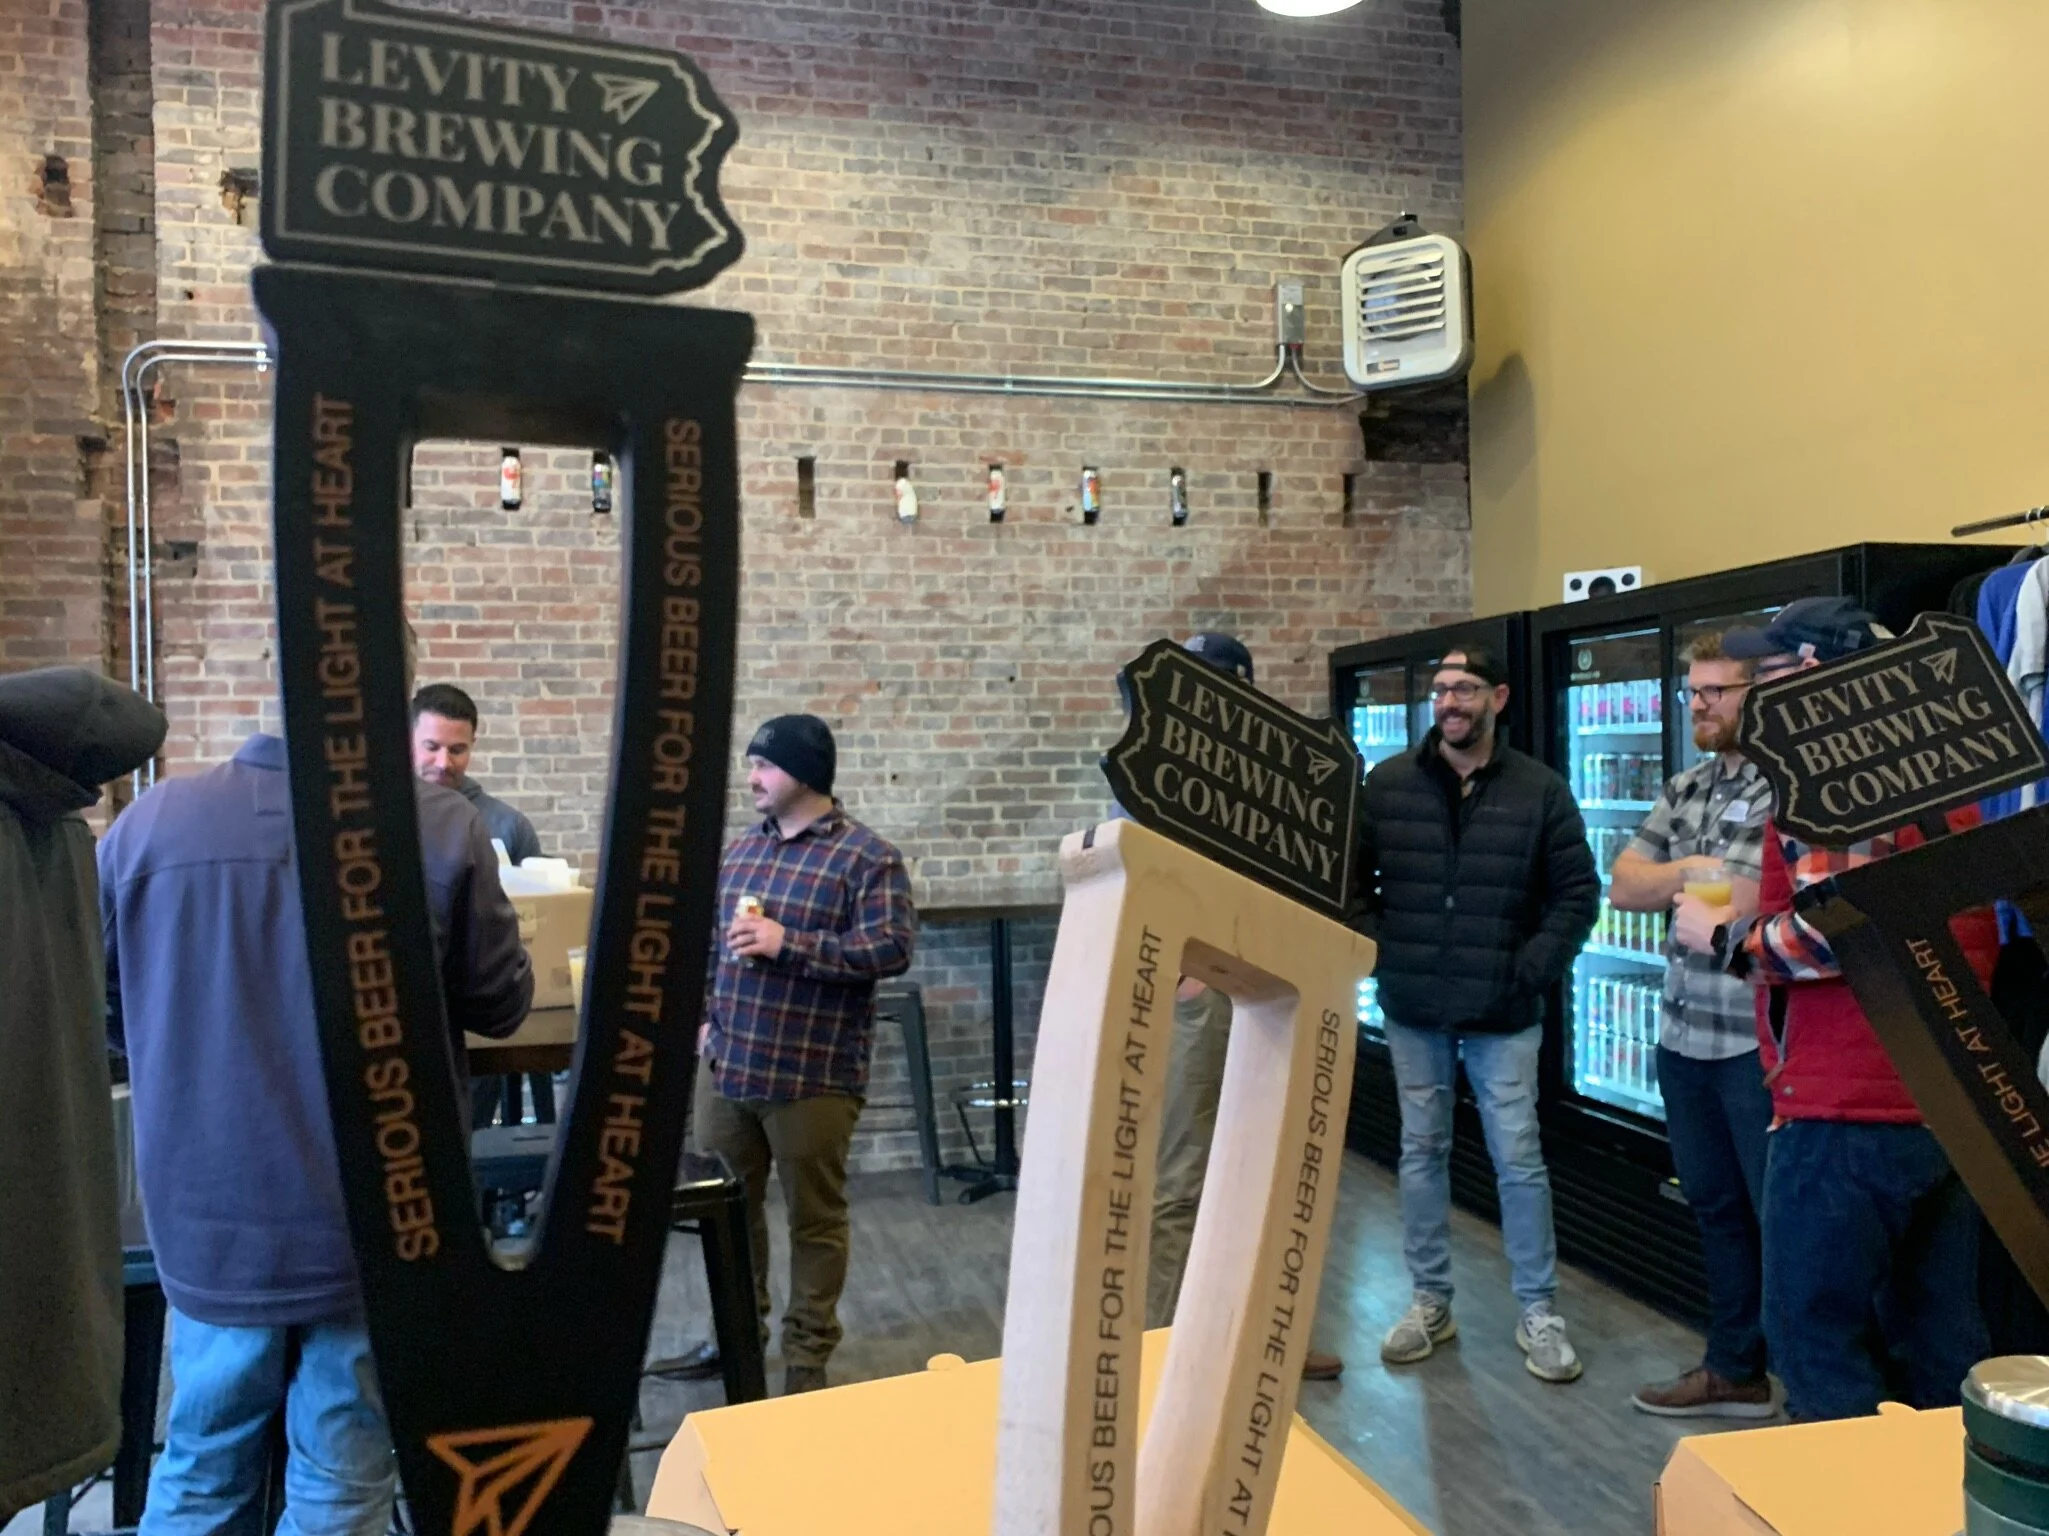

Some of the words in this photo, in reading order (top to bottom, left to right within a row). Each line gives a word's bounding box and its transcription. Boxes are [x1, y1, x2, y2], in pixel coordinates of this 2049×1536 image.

[322, 33, 579, 112] LEVITY
[320, 100, 662, 185] BREWING
[316, 166, 680, 250] COMPANY
[312, 393, 353, 527] HEART
[665, 419, 702, 587] SERIOUS
[315, 538, 354, 587] AT
[317, 599, 365, 722] LIGHT
[661, 597, 699, 699] BEER
[1168, 670, 1299, 767] LEVITY
[1774, 662, 1919, 734] LEVITY
[1795, 687, 1991, 776] BREWING
[326, 728, 370, 819] THE
[652, 710, 694, 793] FOR
[1161, 714, 1334, 835] BREWING
[1821, 722, 2019, 815] COMPANY
[641, 805, 685, 884] THE
[1155, 763, 1338, 882] COMPANY
[334, 829, 383, 920] FOR
[348, 930, 402, 1048] BEER
[625, 893, 674, 1022] LIGHT
[1131, 925, 1162, 1028] HEART
[1906, 939, 1966, 1019] HEART
[614, 1029, 655, 1085] AT
[1125, 1031, 1148, 1074] AT
[1309, 1009, 1339, 1136] SERIOUS
[1956, 1027, 1989, 1051] AT
[1113, 1078, 1140, 1180] LIGHT
[1978, 1063, 2040, 1136] LIGHT
[365, 1057, 438, 1261] SERIOUS
[588, 1094, 646, 1244] HEART
[1294, 1142, 1322, 1223] BEER
[1106, 1189, 1131, 1255] THE
[1280, 1228, 1307, 1295] FOR
[1100, 1269, 1124, 1340] FOR
[1265, 1305, 1294, 1367] THE
[1094, 1351, 1119, 1447] BEER
[1241, 1373, 1277, 1475] LIGHT
[1229, 1479, 1252, 1525] AT
